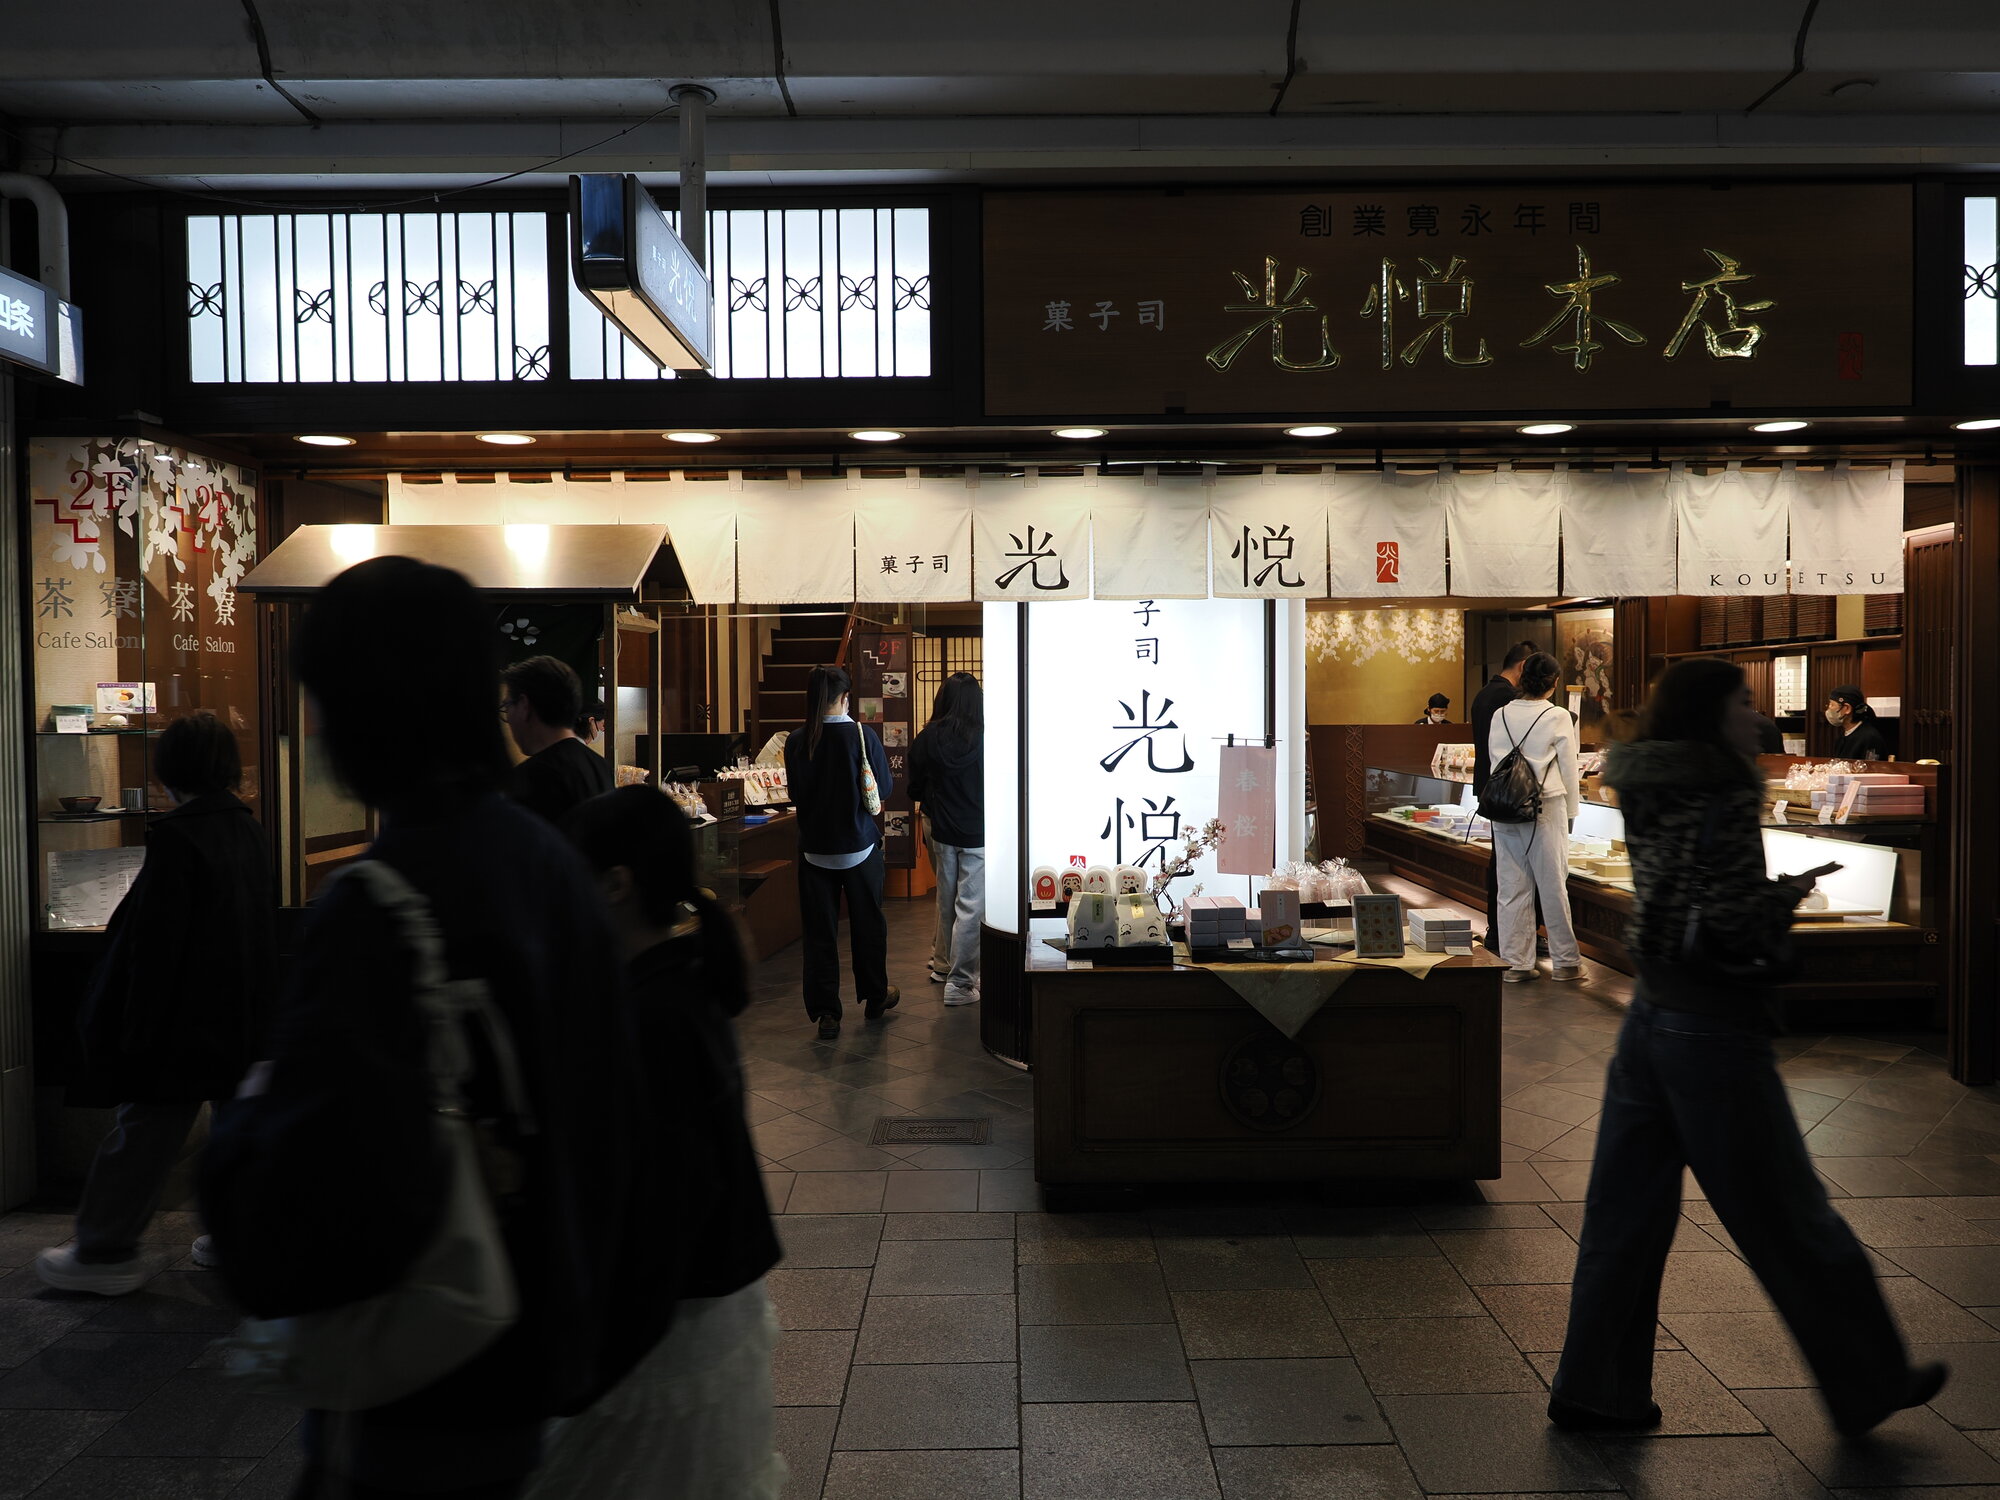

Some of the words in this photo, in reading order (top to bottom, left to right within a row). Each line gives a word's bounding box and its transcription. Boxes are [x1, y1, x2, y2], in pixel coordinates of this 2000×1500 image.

[1299, 202, 1601, 237] 創業寛永年間
[669, 249, 697, 323] 光悦
[1041, 299, 1165, 333] 菓子司
[1206, 243, 1777, 373] 光悦本店
[70, 469, 134, 511] 2F
[196, 485, 232, 527] 2F
[879, 554, 950, 576] 菓子司
[1710, 571, 1886, 587] KOUETSU
[36, 577, 139, 619] 茶寮
[171, 581, 236, 627] 茶寮
[37, 631, 81, 649] Cafe
[84, 631, 140, 650] Salon
[173, 634, 200, 652] Cafe
[205, 636, 236, 654] Salon
[879, 640, 902, 655] 2F
[889, 755, 903, 769] 寮
[1100, 689, 1195, 876] 光悦
[1234, 768, 1260, 838] 春桜
